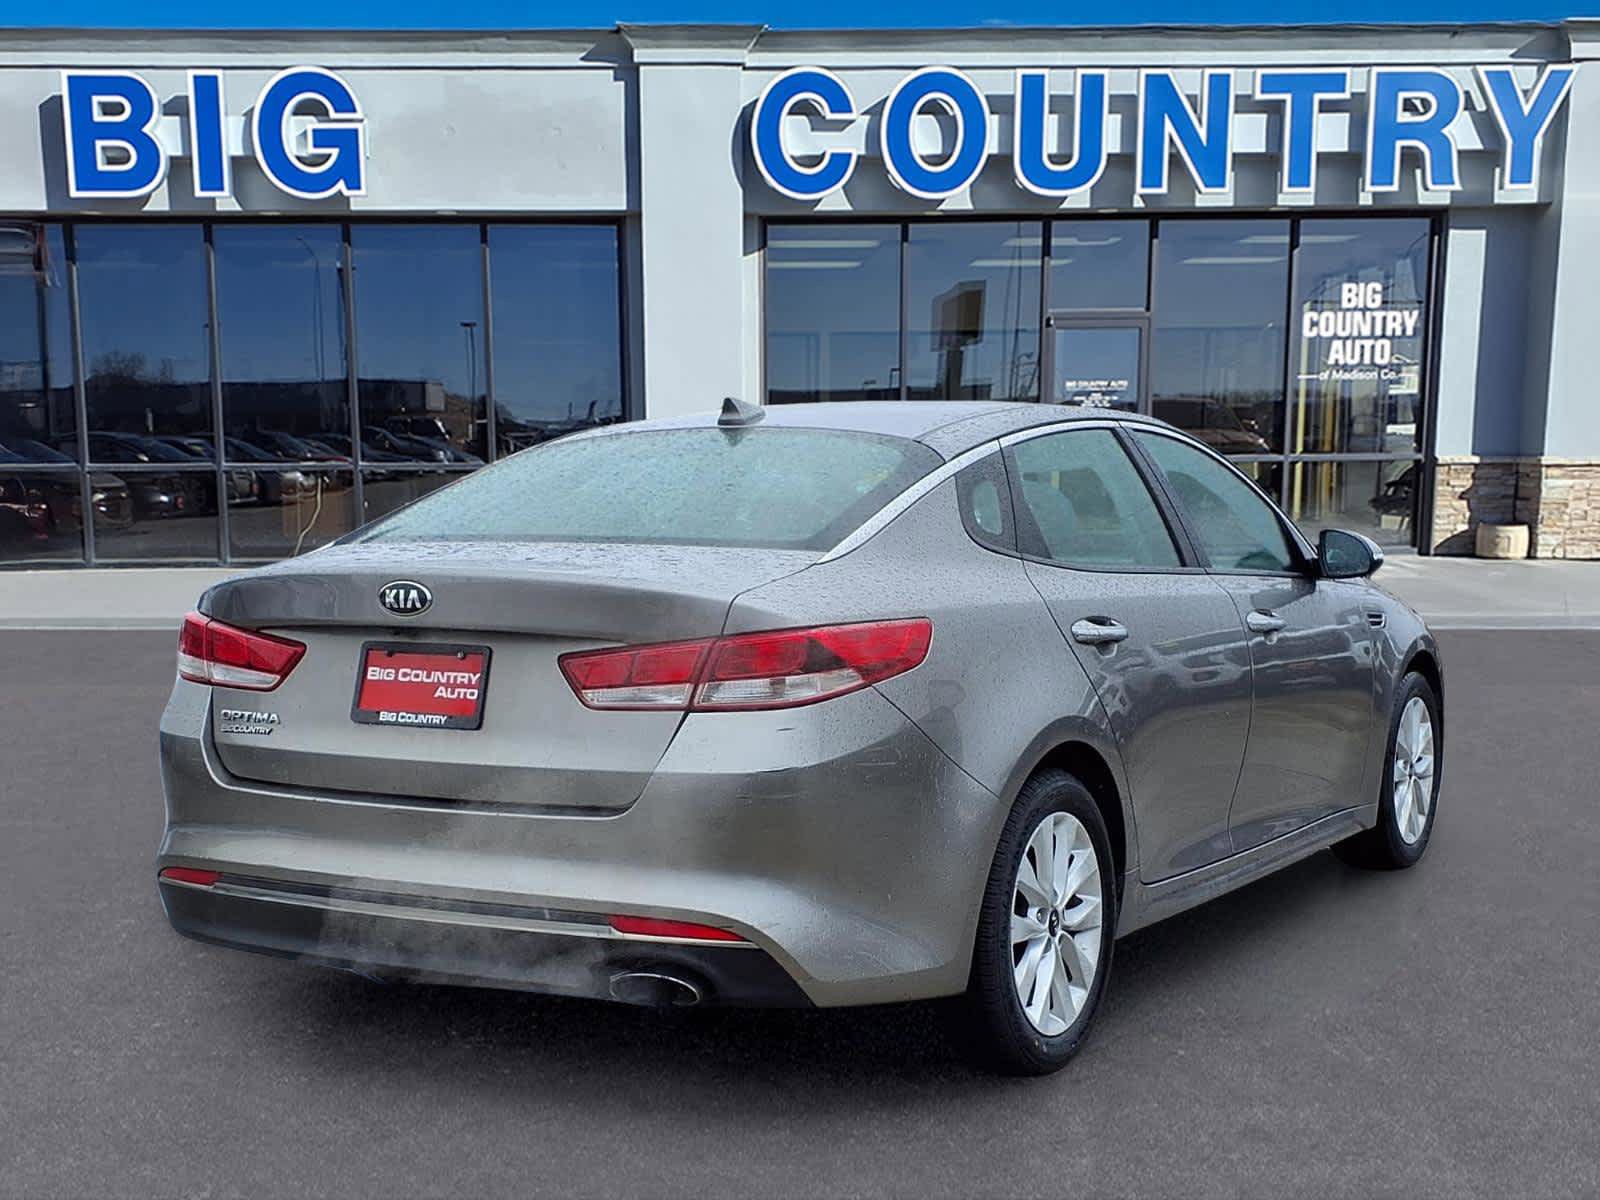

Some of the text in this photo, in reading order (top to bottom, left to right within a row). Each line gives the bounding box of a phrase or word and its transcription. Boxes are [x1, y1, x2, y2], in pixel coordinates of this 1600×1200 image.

[60, 64, 1576, 202] BIG COUNTRY
[1341, 281, 1383, 309] BIG
[1303, 309, 1420, 337] COUNTRY
[1327, 338, 1392, 366] AUTO
[1331, 368, 1378, 380] Madison
[385, 589, 422, 609] KIA
[367, 666, 480, 685] BIG COUNTRY
[434, 686, 479, 700] AUTO
[221, 709, 280, 724] OPTIMA
[379, 711, 448, 725] BIG COUNTRY
